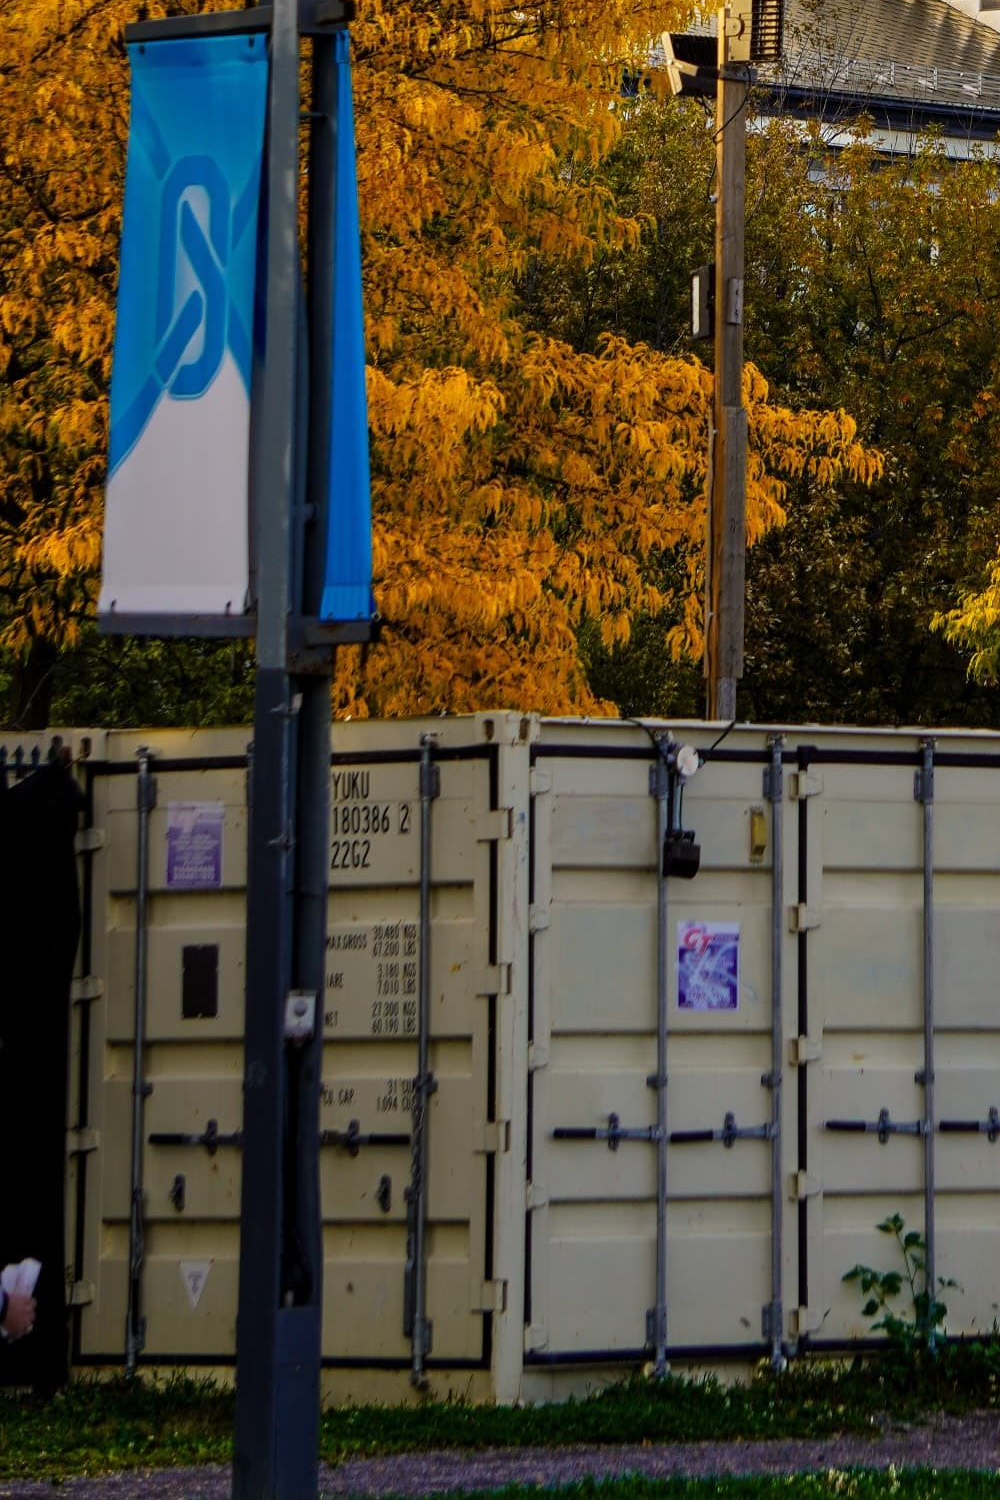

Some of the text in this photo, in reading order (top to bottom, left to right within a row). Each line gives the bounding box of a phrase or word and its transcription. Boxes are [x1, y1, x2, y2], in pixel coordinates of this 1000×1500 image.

[332, 771, 370, 799] YUKU
[333, 804, 410, 835] 180386 2
[331, 840, 370, 869] 22G2
